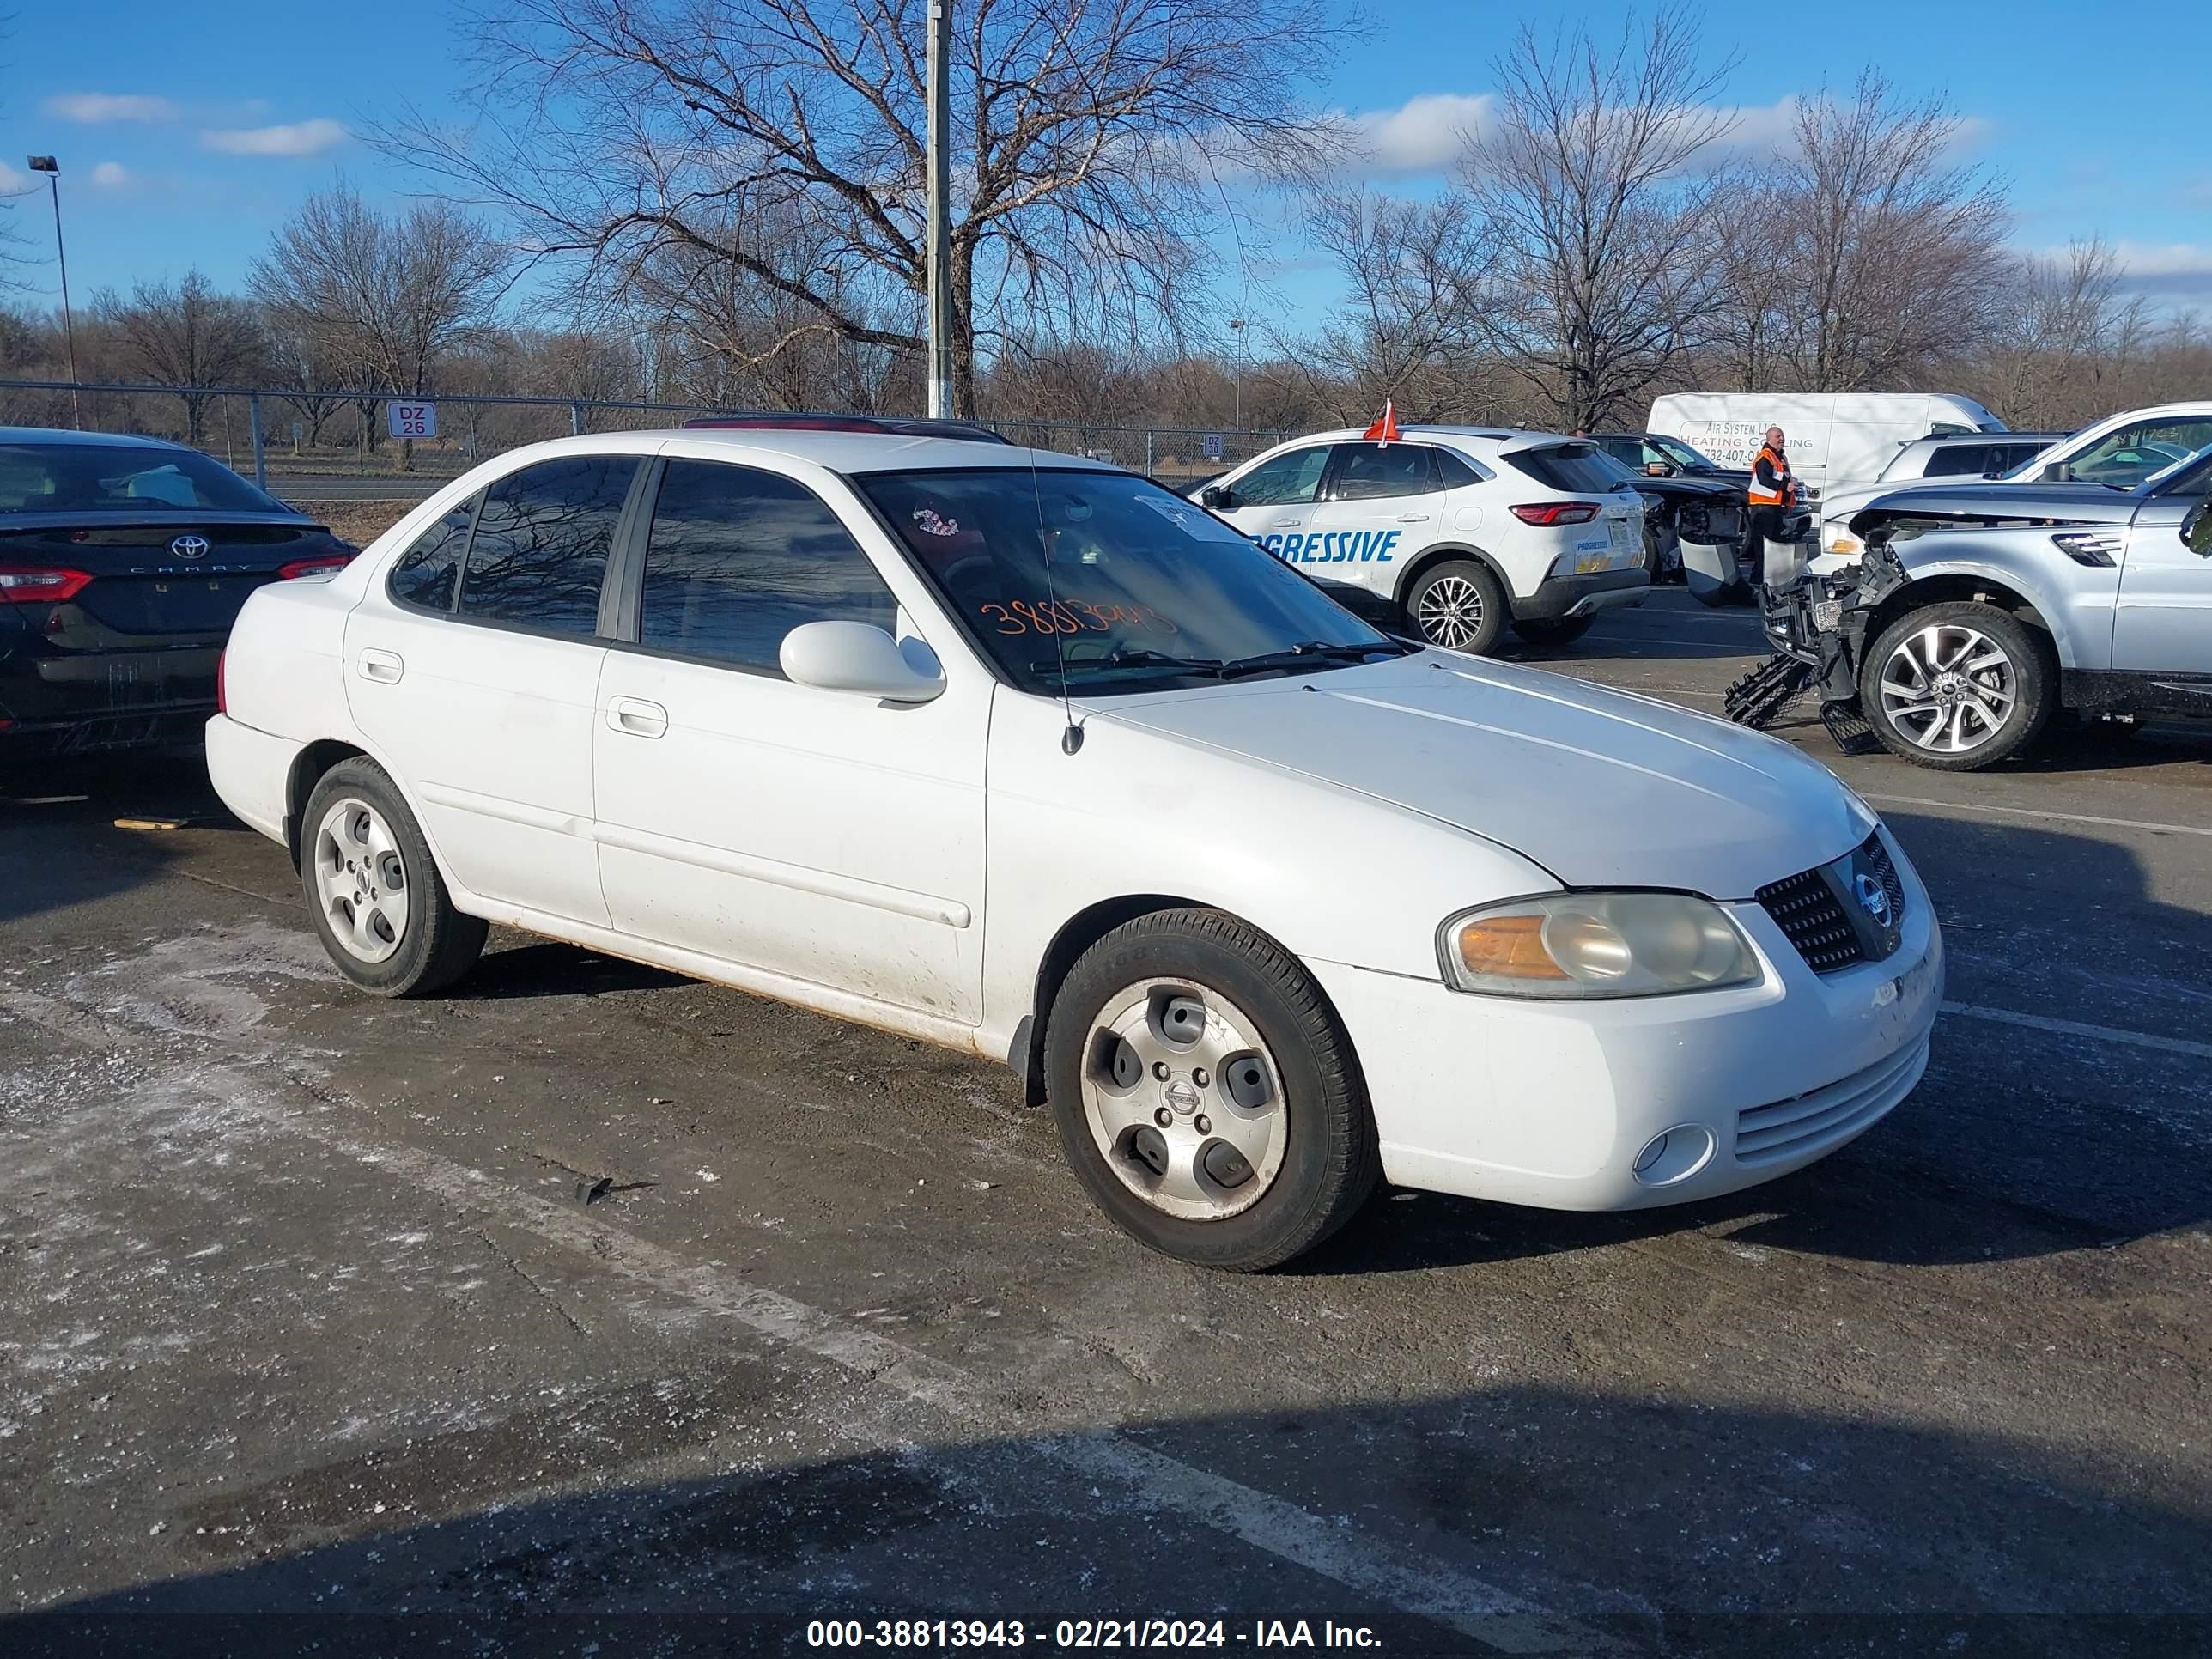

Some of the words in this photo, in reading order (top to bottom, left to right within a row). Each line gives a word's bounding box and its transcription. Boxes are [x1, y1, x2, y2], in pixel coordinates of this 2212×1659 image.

[399, 407, 426, 420] DZ
[403, 421, 425, 434] 26
[1706, 422, 1721, 434] AIR
[1724, 422, 1755, 434] SYSTEM
[1208, 436, 1219, 446] DZ
[1680, 435, 1742, 447] HEATING
[1748, 437, 1814, 447] COING
[1209, 445, 1218, 454] 30
[1704, 449, 1759, 462] 732-407-0
[130, 564, 251, 574] CAMRY
